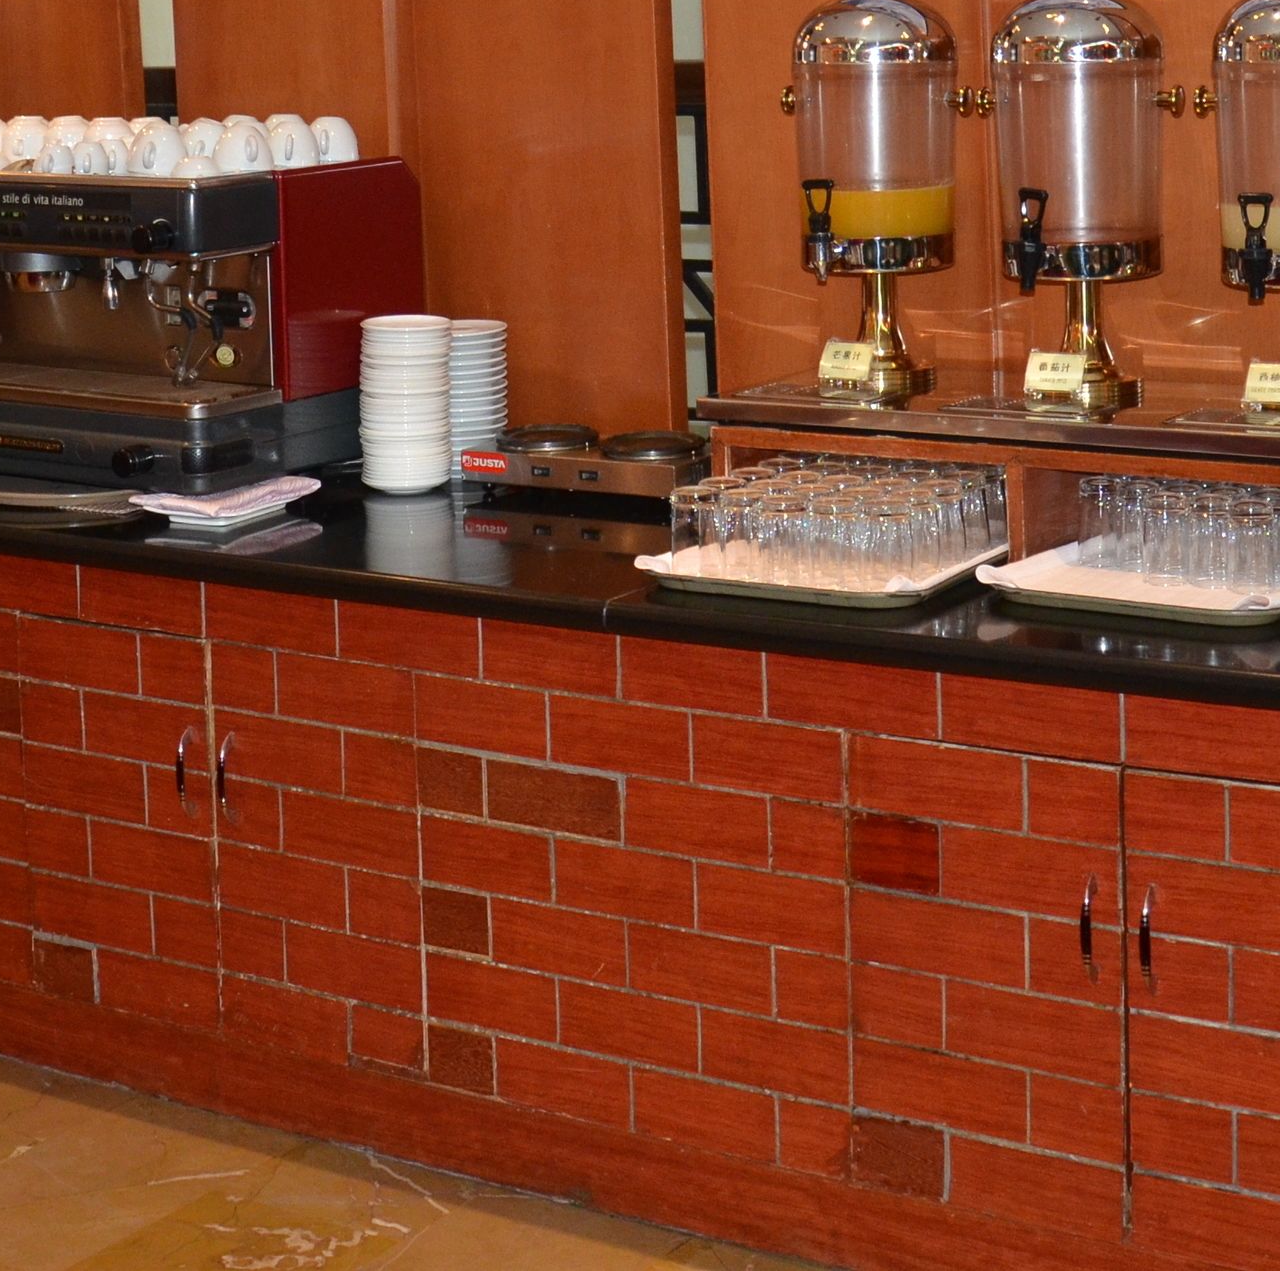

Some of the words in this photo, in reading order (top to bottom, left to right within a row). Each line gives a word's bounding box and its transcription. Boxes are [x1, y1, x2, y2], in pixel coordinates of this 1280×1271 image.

[2, 194, 20, 204] stile
[21, 194, 31, 205] di
[33, 195, 49, 206] vita
[51, 195, 84, 207] italiano
[473, 457, 506, 469] JUSTA
